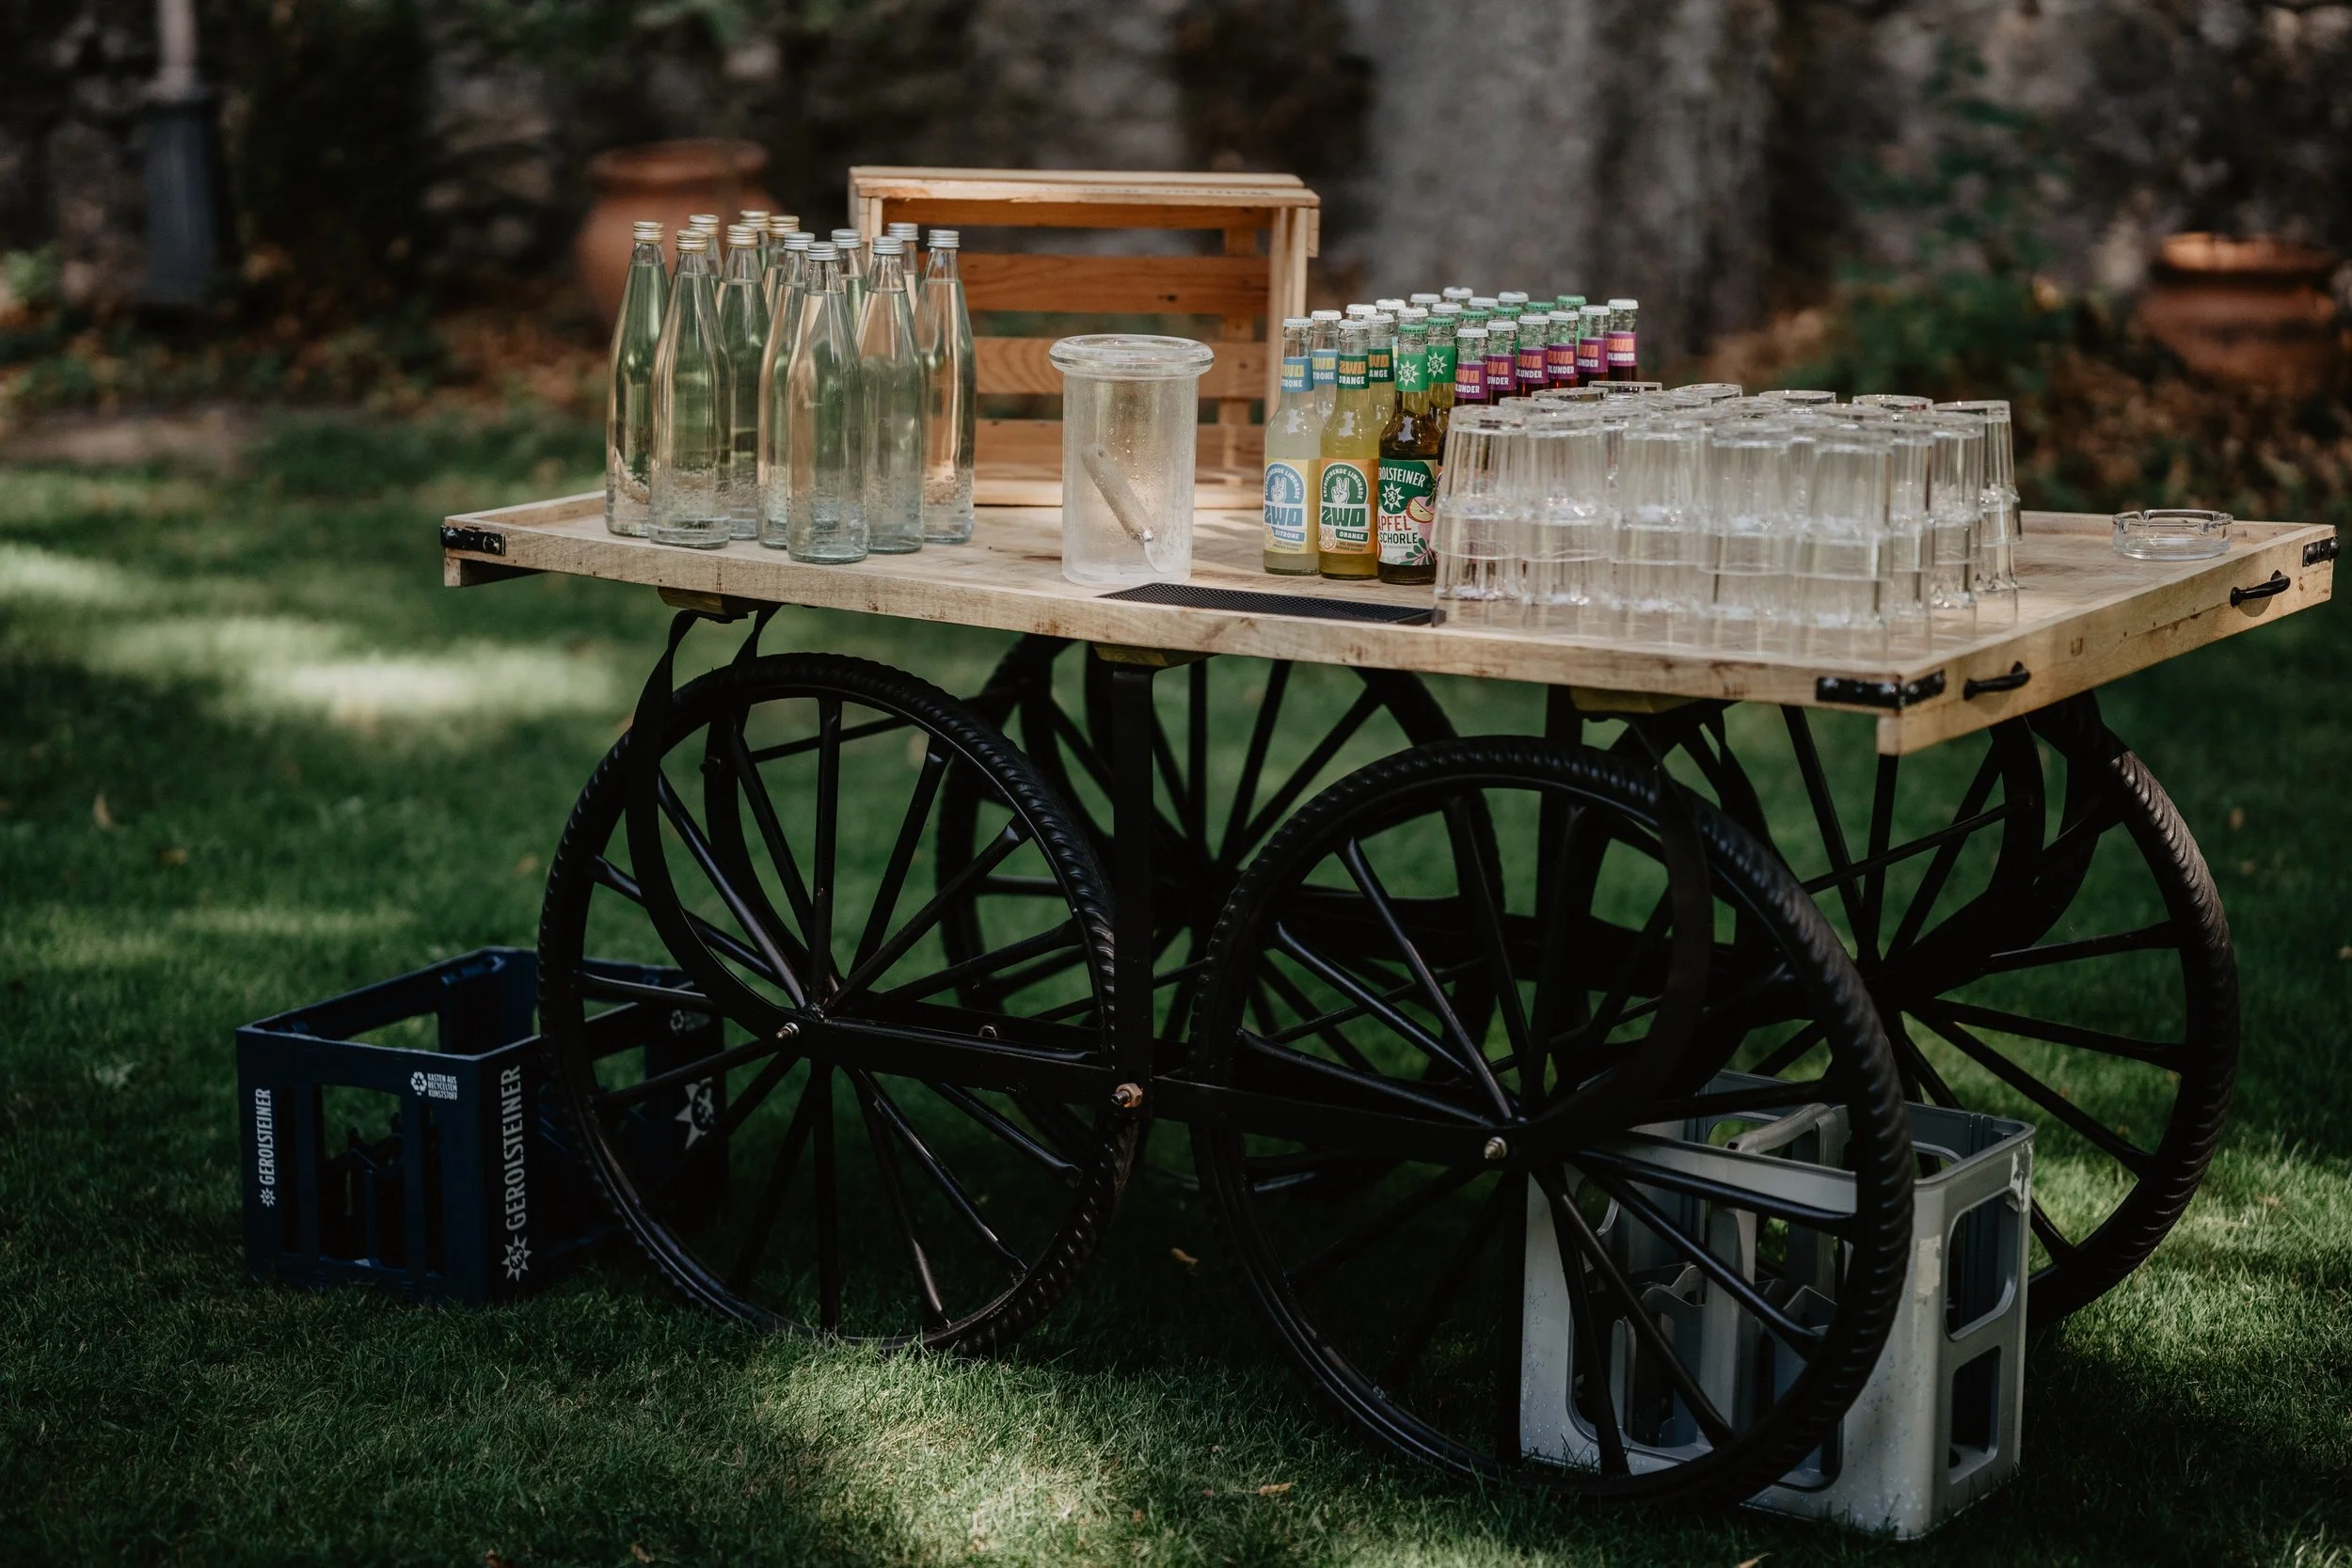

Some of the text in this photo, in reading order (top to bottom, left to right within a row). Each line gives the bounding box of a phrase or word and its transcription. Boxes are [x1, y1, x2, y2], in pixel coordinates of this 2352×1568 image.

[1339, 360, 1366, 374] ZWO
[1369, 354, 1390, 368] WO
[1312, 371, 1334, 381] TRONE
[1369, 369, 1388, 378] ANGE
[1281, 378, 1303, 388] TRONE
[1339, 375, 1365, 385] ORANGE
[1487, 376, 1509, 386] UNDER
[1455, 383, 1480, 393] LUNDER
[1347, 469, 1364, 499] LIMONADE
[1264, 504, 1303, 527] ZWO
[1321, 505, 1366, 527] ZWO
[1275, 530, 1300, 540] ZITRONE
[1339, 531, 1364, 540] ORANGE
[1379, 531, 1418, 545] SCHORLE
[256, 1088, 276, 1186] GEROLSTEINER
[501, 1065, 527, 1231] GEROLSTEINER
